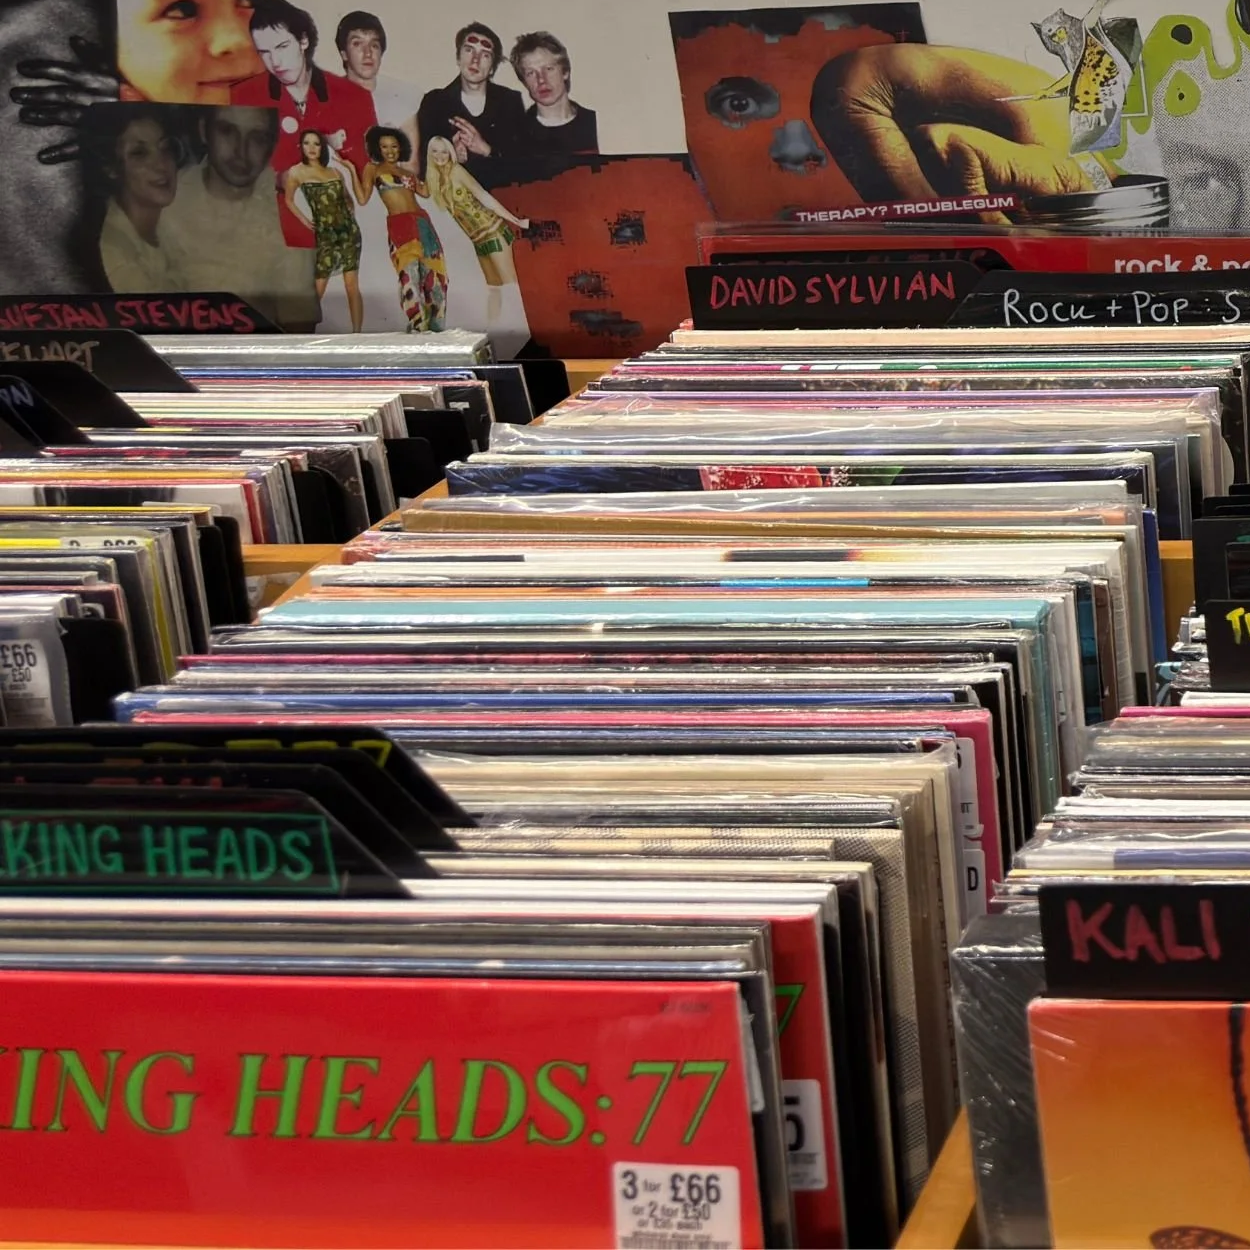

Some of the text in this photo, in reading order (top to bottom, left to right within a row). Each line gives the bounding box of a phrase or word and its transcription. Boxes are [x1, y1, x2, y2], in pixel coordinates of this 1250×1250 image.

[796, 196, 1014, 223] THERAPY? TROUBLEGUM
[1114, 254, 1213, 275] rock &
[710, 270, 957, 310] DAVID SYLVIAN
[1106, 297, 1125, 318] +
[1132, 290, 1189, 326] Pop
[1221, 291, 1242, 324] S
[113, 298, 256, 334] STEVENS
[11, 667, 32, 683] £50
[141, 824, 315, 882] HEADS
[1066, 899, 1221, 965] KALI
[0, 1046, 200, 1136] ING
[621, 1170, 721, 1204] 3 for £66
[648, 1201, 659, 1218] 2
